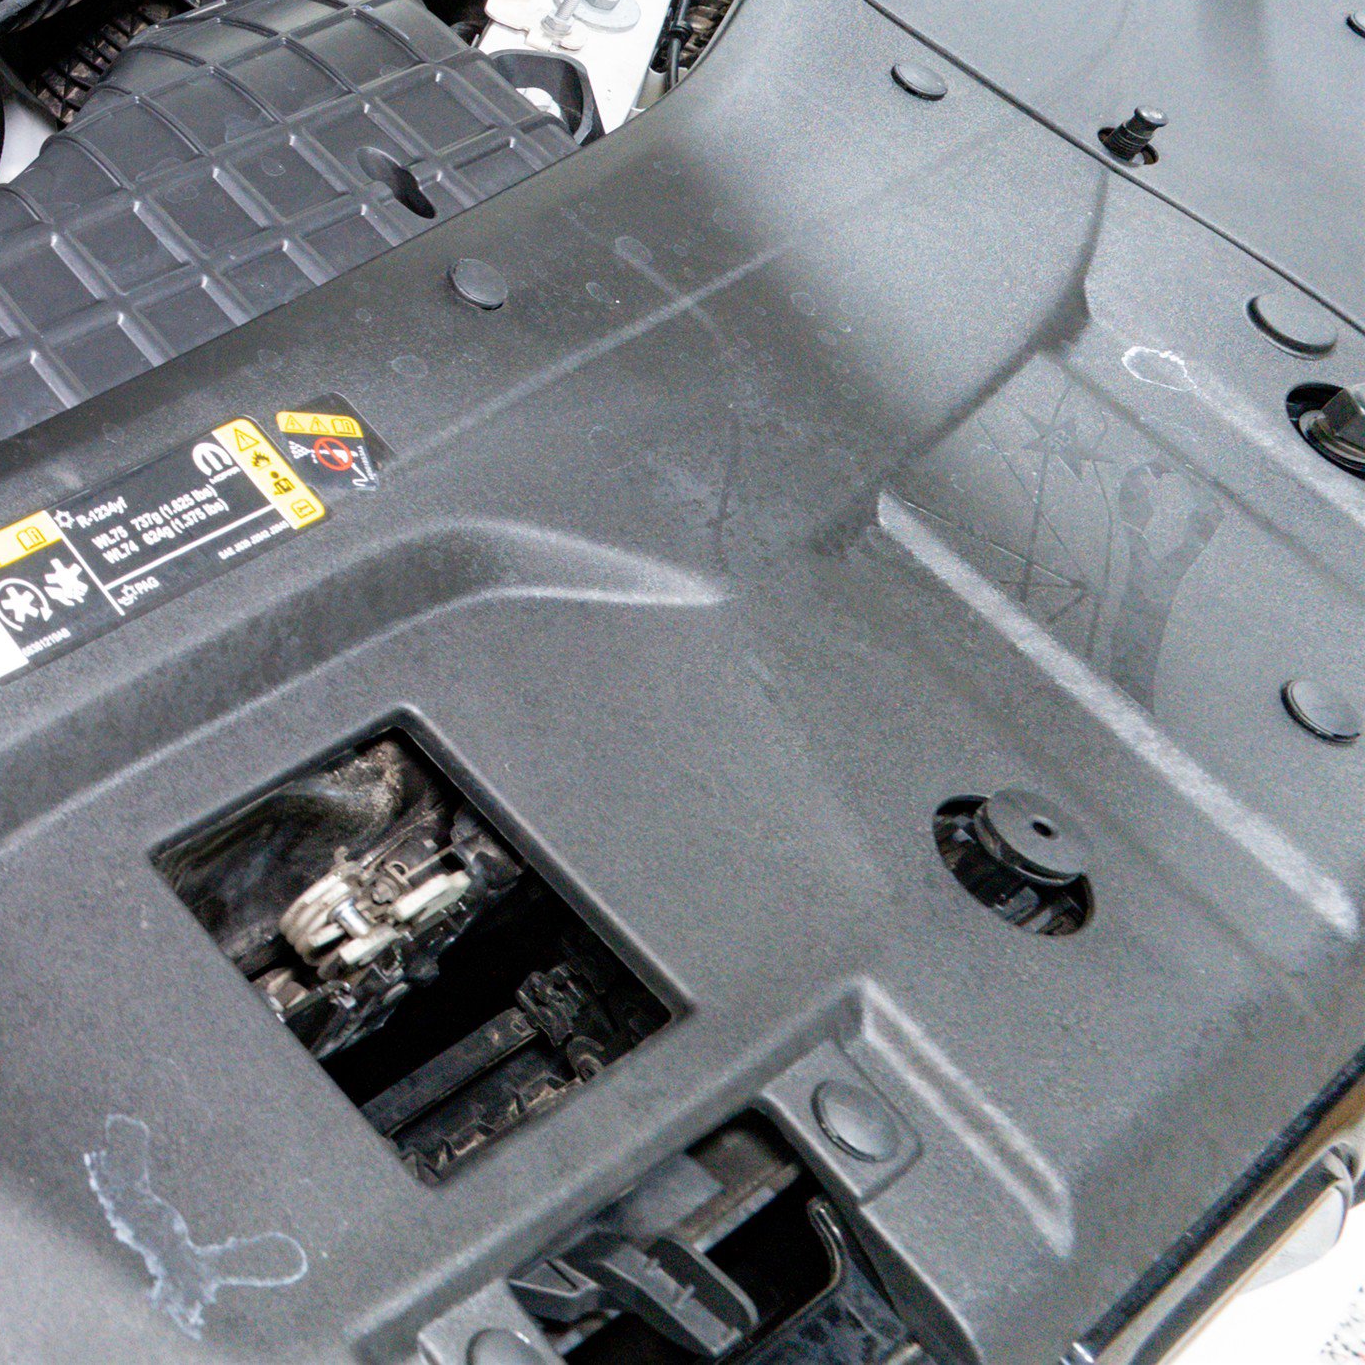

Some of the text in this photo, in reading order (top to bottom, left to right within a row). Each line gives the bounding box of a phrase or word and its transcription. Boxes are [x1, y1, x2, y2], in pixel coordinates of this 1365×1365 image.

[75, 496, 129, 529] R-1234yf
[91, 525, 129, 550] WL75
[130, 511, 164, 532] 737g
[193, 483, 219, 502] lbs)
[102, 540, 140, 565] WL74
[170, 508, 207, 534] (1.375
[207, 497, 230, 514] lbs)
[136, 576, 160, 598] PAG
